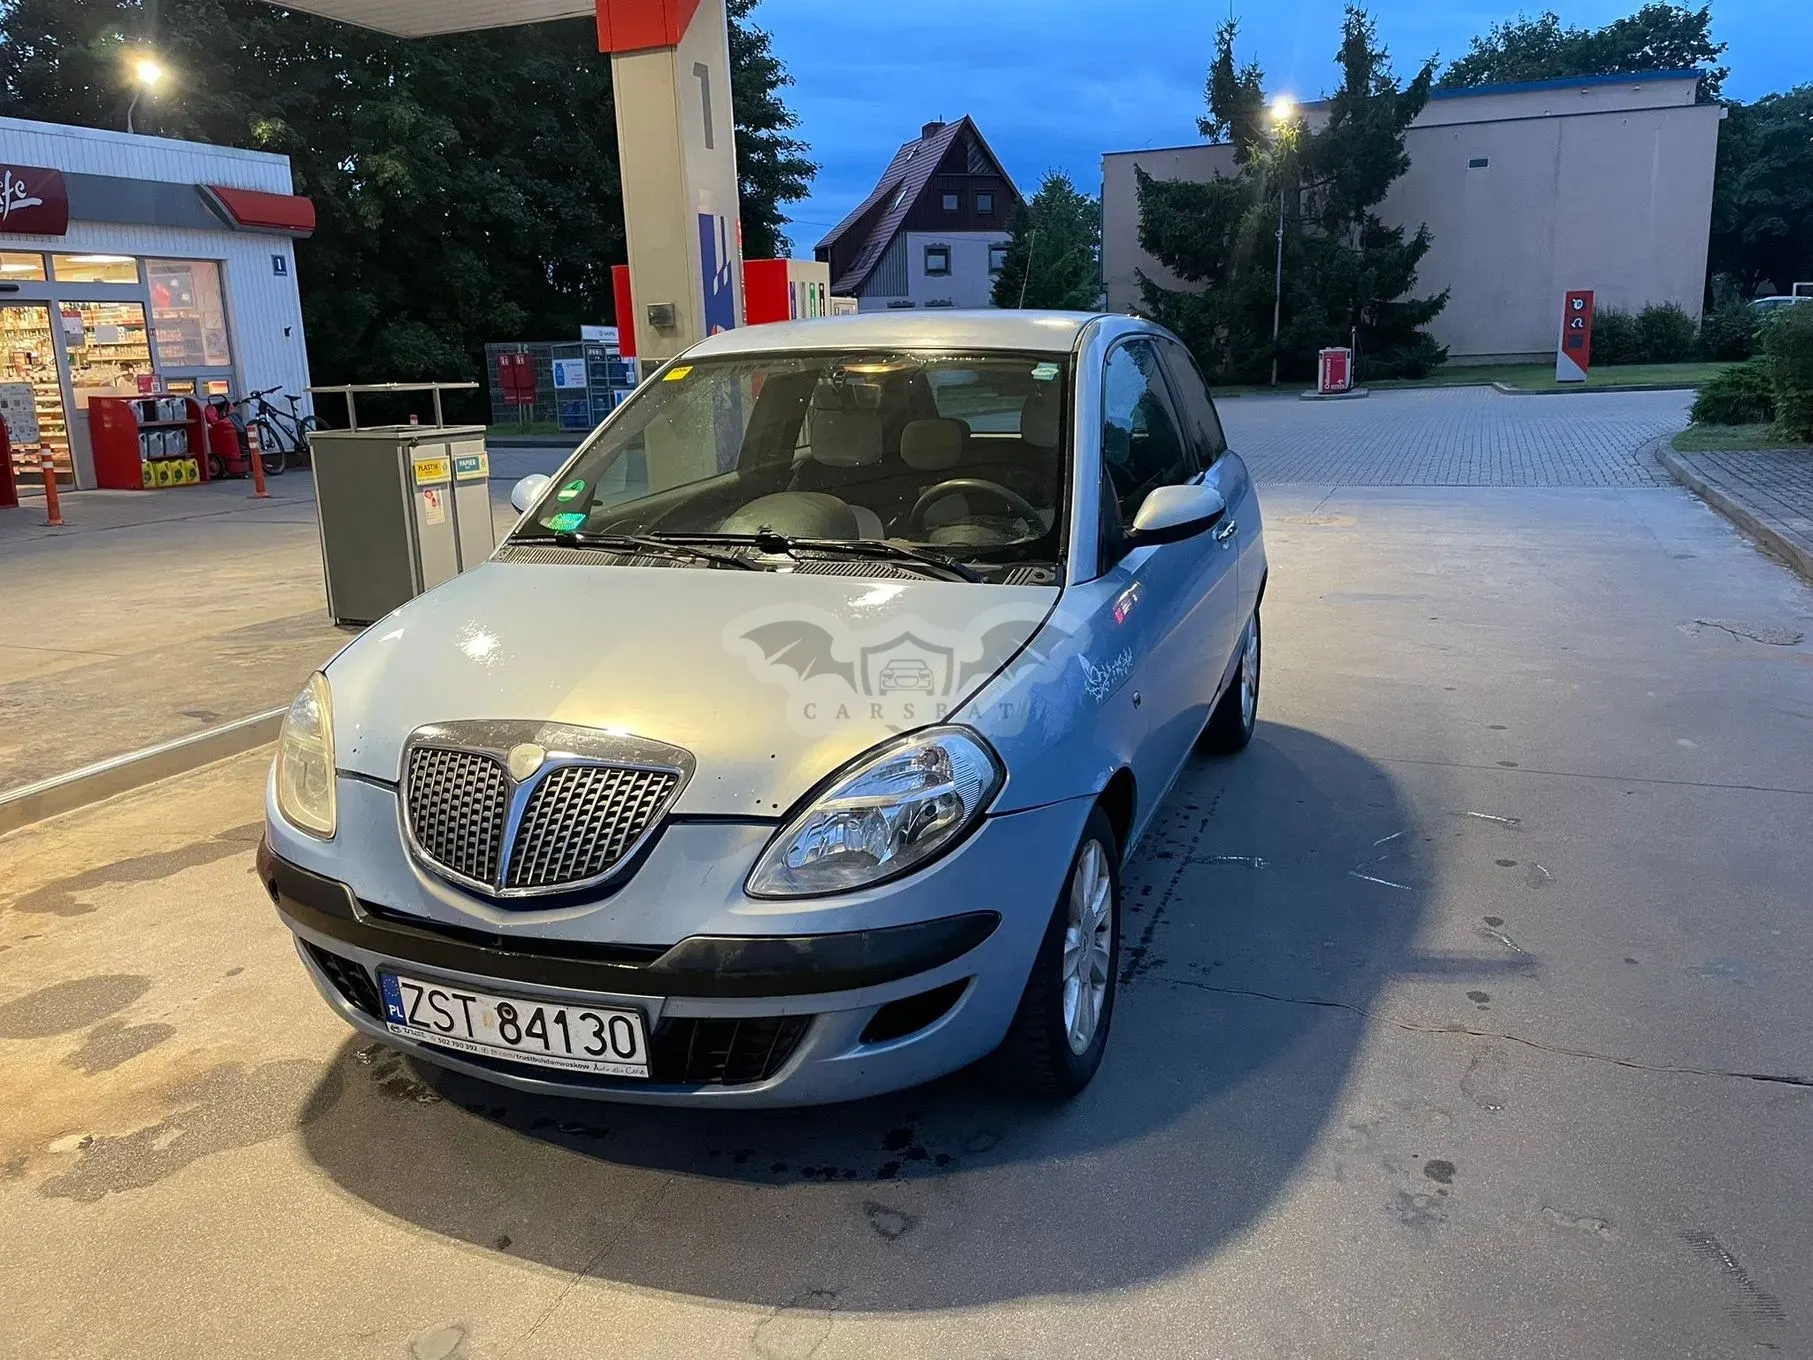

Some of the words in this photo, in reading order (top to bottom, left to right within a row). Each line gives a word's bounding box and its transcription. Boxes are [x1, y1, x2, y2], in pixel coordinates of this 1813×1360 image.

[692, 61, 714, 150] 1
[0, 170, 28, 221] fe
[389, 1004, 404, 1018] PL
[401, 983, 476, 1038] ZST
[497, 1001, 637, 1060] 84130
